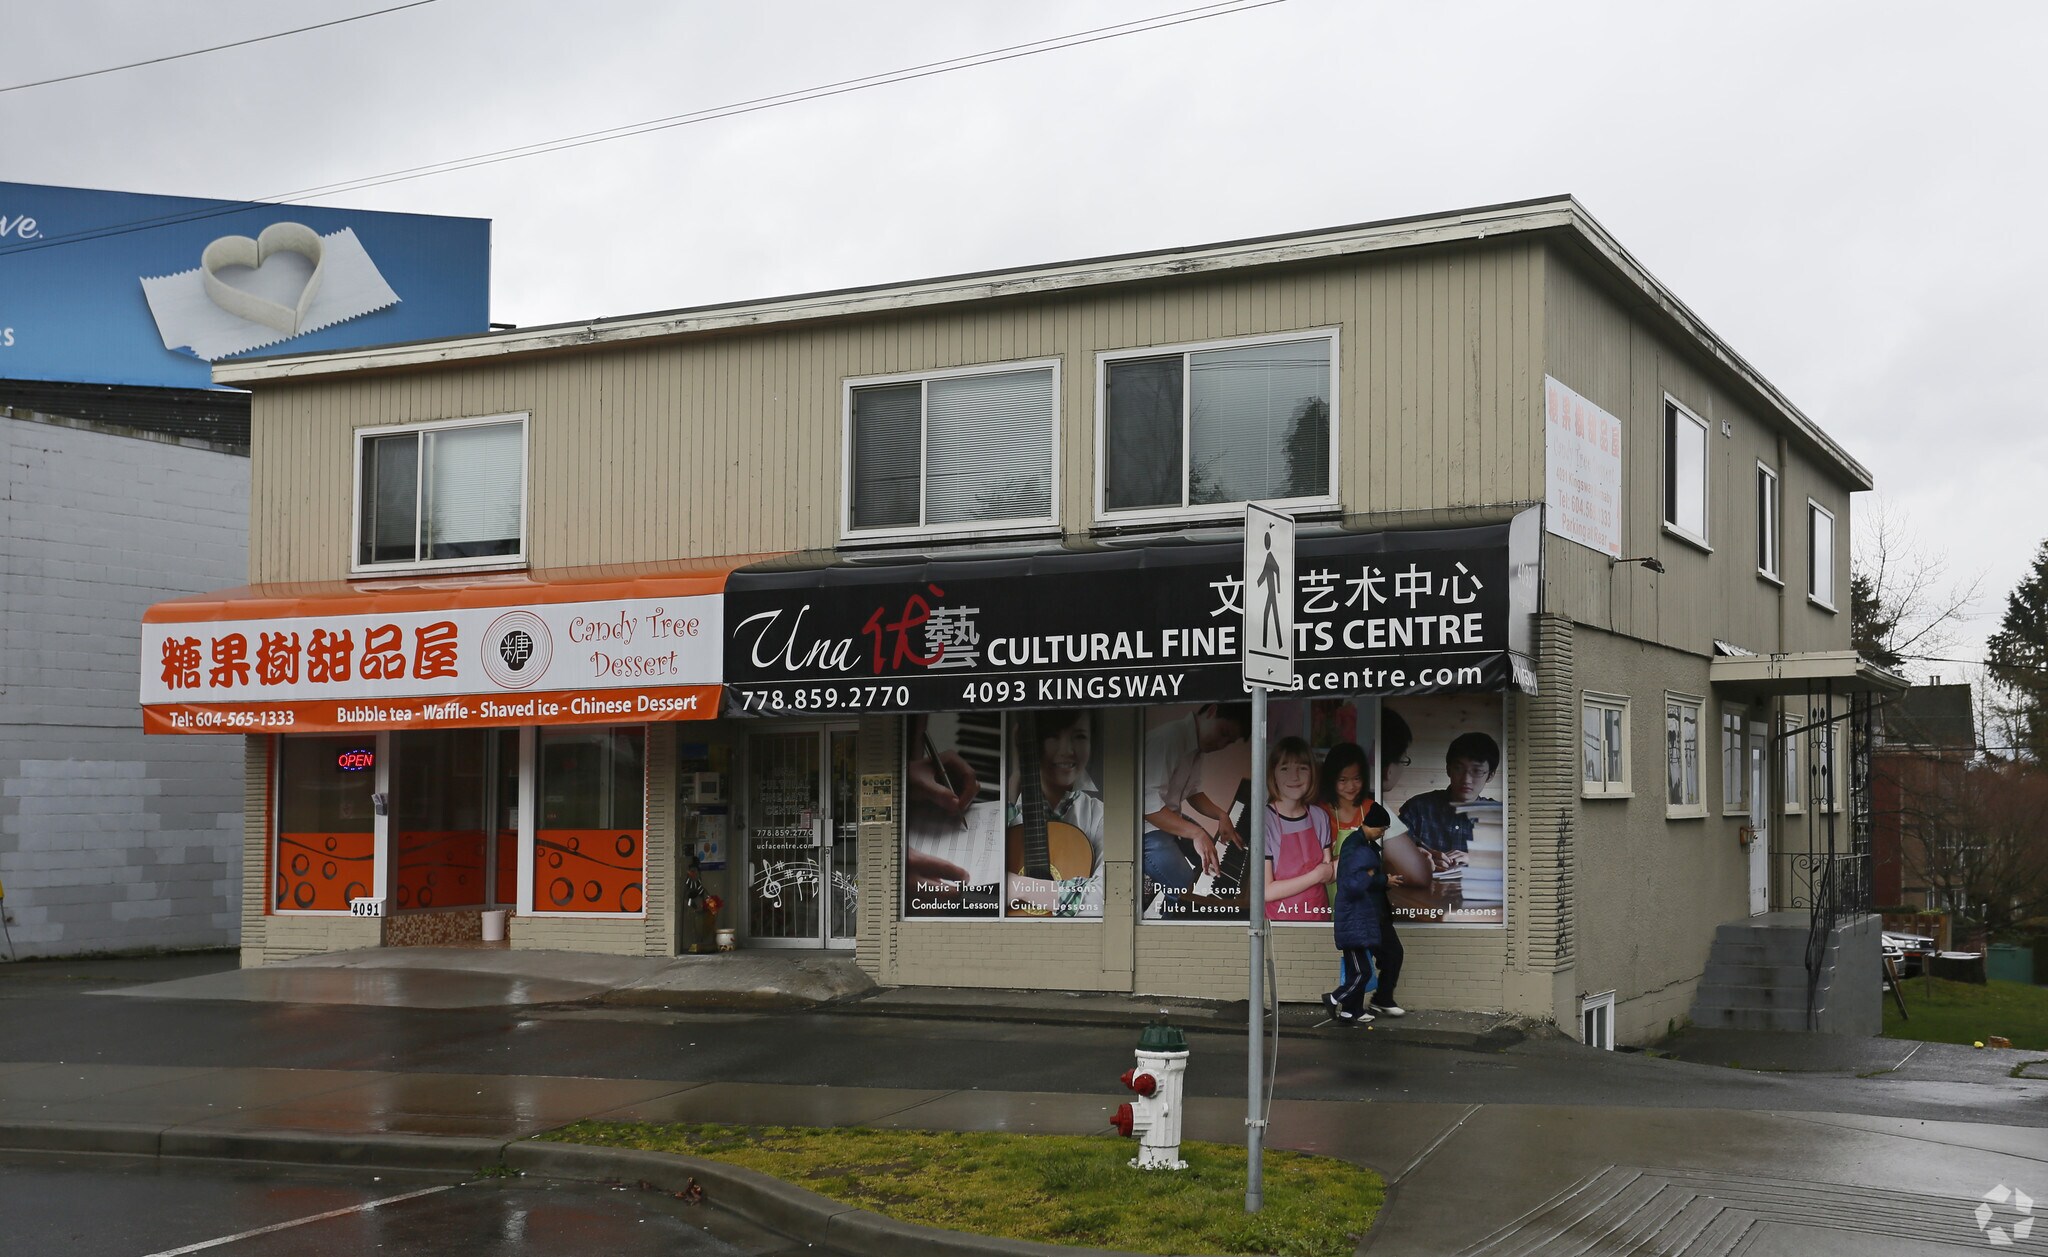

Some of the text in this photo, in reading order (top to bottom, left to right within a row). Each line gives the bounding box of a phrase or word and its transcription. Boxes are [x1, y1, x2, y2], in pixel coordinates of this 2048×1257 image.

[1562, 512, 1586, 542] Parking
[1209, 561, 1484, 618] 文艺术中心
[569, 607, 699, 645] Candy Tree
[733, 604, 861, 671] Una
[987, 630, 1153, 666] CULTURAL
[1162, 626, 1236, 658] FINE
[1293, 621, 1334, 651] TS
[1342, 612, 1484, 650] CENTRE
[161, 621, 459, 690] 糖果樹甜品屋
[590, 650, 678, 678] Dessert
[742, 666, 1482, 710] 778.859.2770 4093 KINGSWAY acentre.com
[337, 705, 387, 723] Bubble
[390, 707, 412, 721] tea
[423, 702, 468, 720] Waffle
[480, 699, 533, 718] Shaved
[538, 699, 558, 716] ice
[571, 696, 631, 715] Chinese
[637, 694, 697, 712] Dessert
[169, 710, 295, 728] Tel: 604-565-1333
[338, 754, 373, 767] OPEN
[756, 840, 814, 849] ucfacentre.com
[917, 881, 994, 894] Music Theory
[1012, 881, 1097, 892] Violin Lessons
[1154, 882, 1241, 894] Piano Lessons
[352, 902, 379, 916] 4091
[912, 898, 999, 909] Conductor Lessons
[1010, 898, 1098, 910] Guitar Lessons
[1155, 900, 1240, 912] Flute Lessons
[1277, 902, 1335, 914] Art Less
[1391, 903, 1497, 918] anguage Lessons
